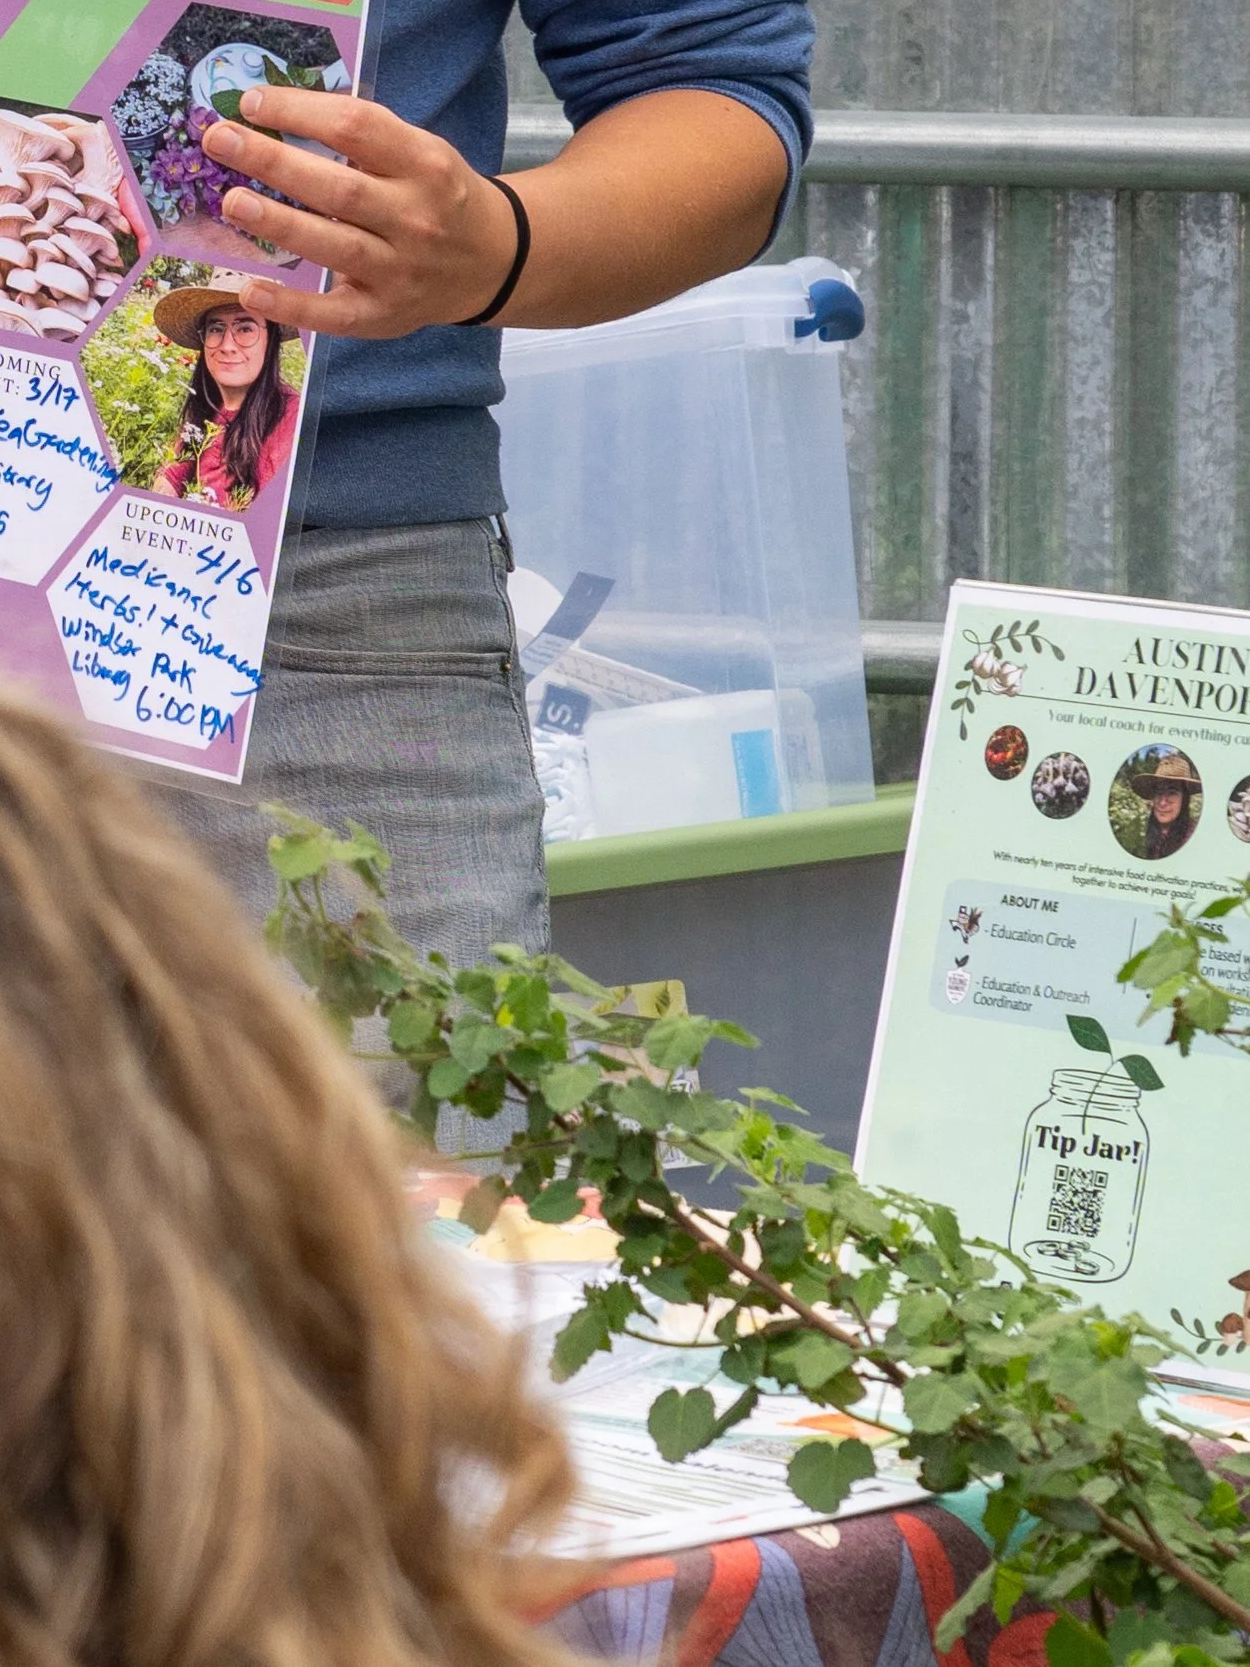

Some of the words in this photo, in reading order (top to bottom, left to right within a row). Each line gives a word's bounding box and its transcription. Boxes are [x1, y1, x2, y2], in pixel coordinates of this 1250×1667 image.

[25, 377, 80, 412] 3/17
[125, 502, 234, 542] UPCOMING
[121, 525, 193, 556] EVENT:
[196, 545, 259, 595] 4/6
[62, 615, 142, 657] Windsor
[151, 652, 197, 694] Park
[1048, 710, 1074, 723] Your
[1078, 713, 1106, 727] local
[1110, 718, 1145, 733] coach
[1149, 722, 1164, 735] for
[1168, 725, 1231, 746] everything
[993, 850, 1012, 862] With
[1014, 855, 1038, 868] nearly
[1040, 858, 1053, 867] ten
[1055, 861, 1077, 873] years
[1078, 862, 1088, 872] of
[1088, 864, 1125, 878] intensive
[1126, 868, 1145, 880] food
[1147, 871, 1189, 886] cultivation
[1001, 894, 1039, 909] ABOUT
[1041, 900, 1060, 913] ME
[1072, 875, 1107, 888] together
[1118, 881, 1149, 894] achieve
[1151, 886, 1168, 897] your
[990, 924, 1044, 944] Education
[1046, 931, 1077, 949] Circle
[1209, 945, 1241, 963] based
[973, 992, 1033, 1012] Coordinator
[981, 976, 1032, 996] Education
[1033, 986, 1041, 997] &
[1043, 985, 1091, 1004] Outreach
[1036, 1125, 1076, 1159] Tip
[1083, 1134, 1144, 1164] Jar!
